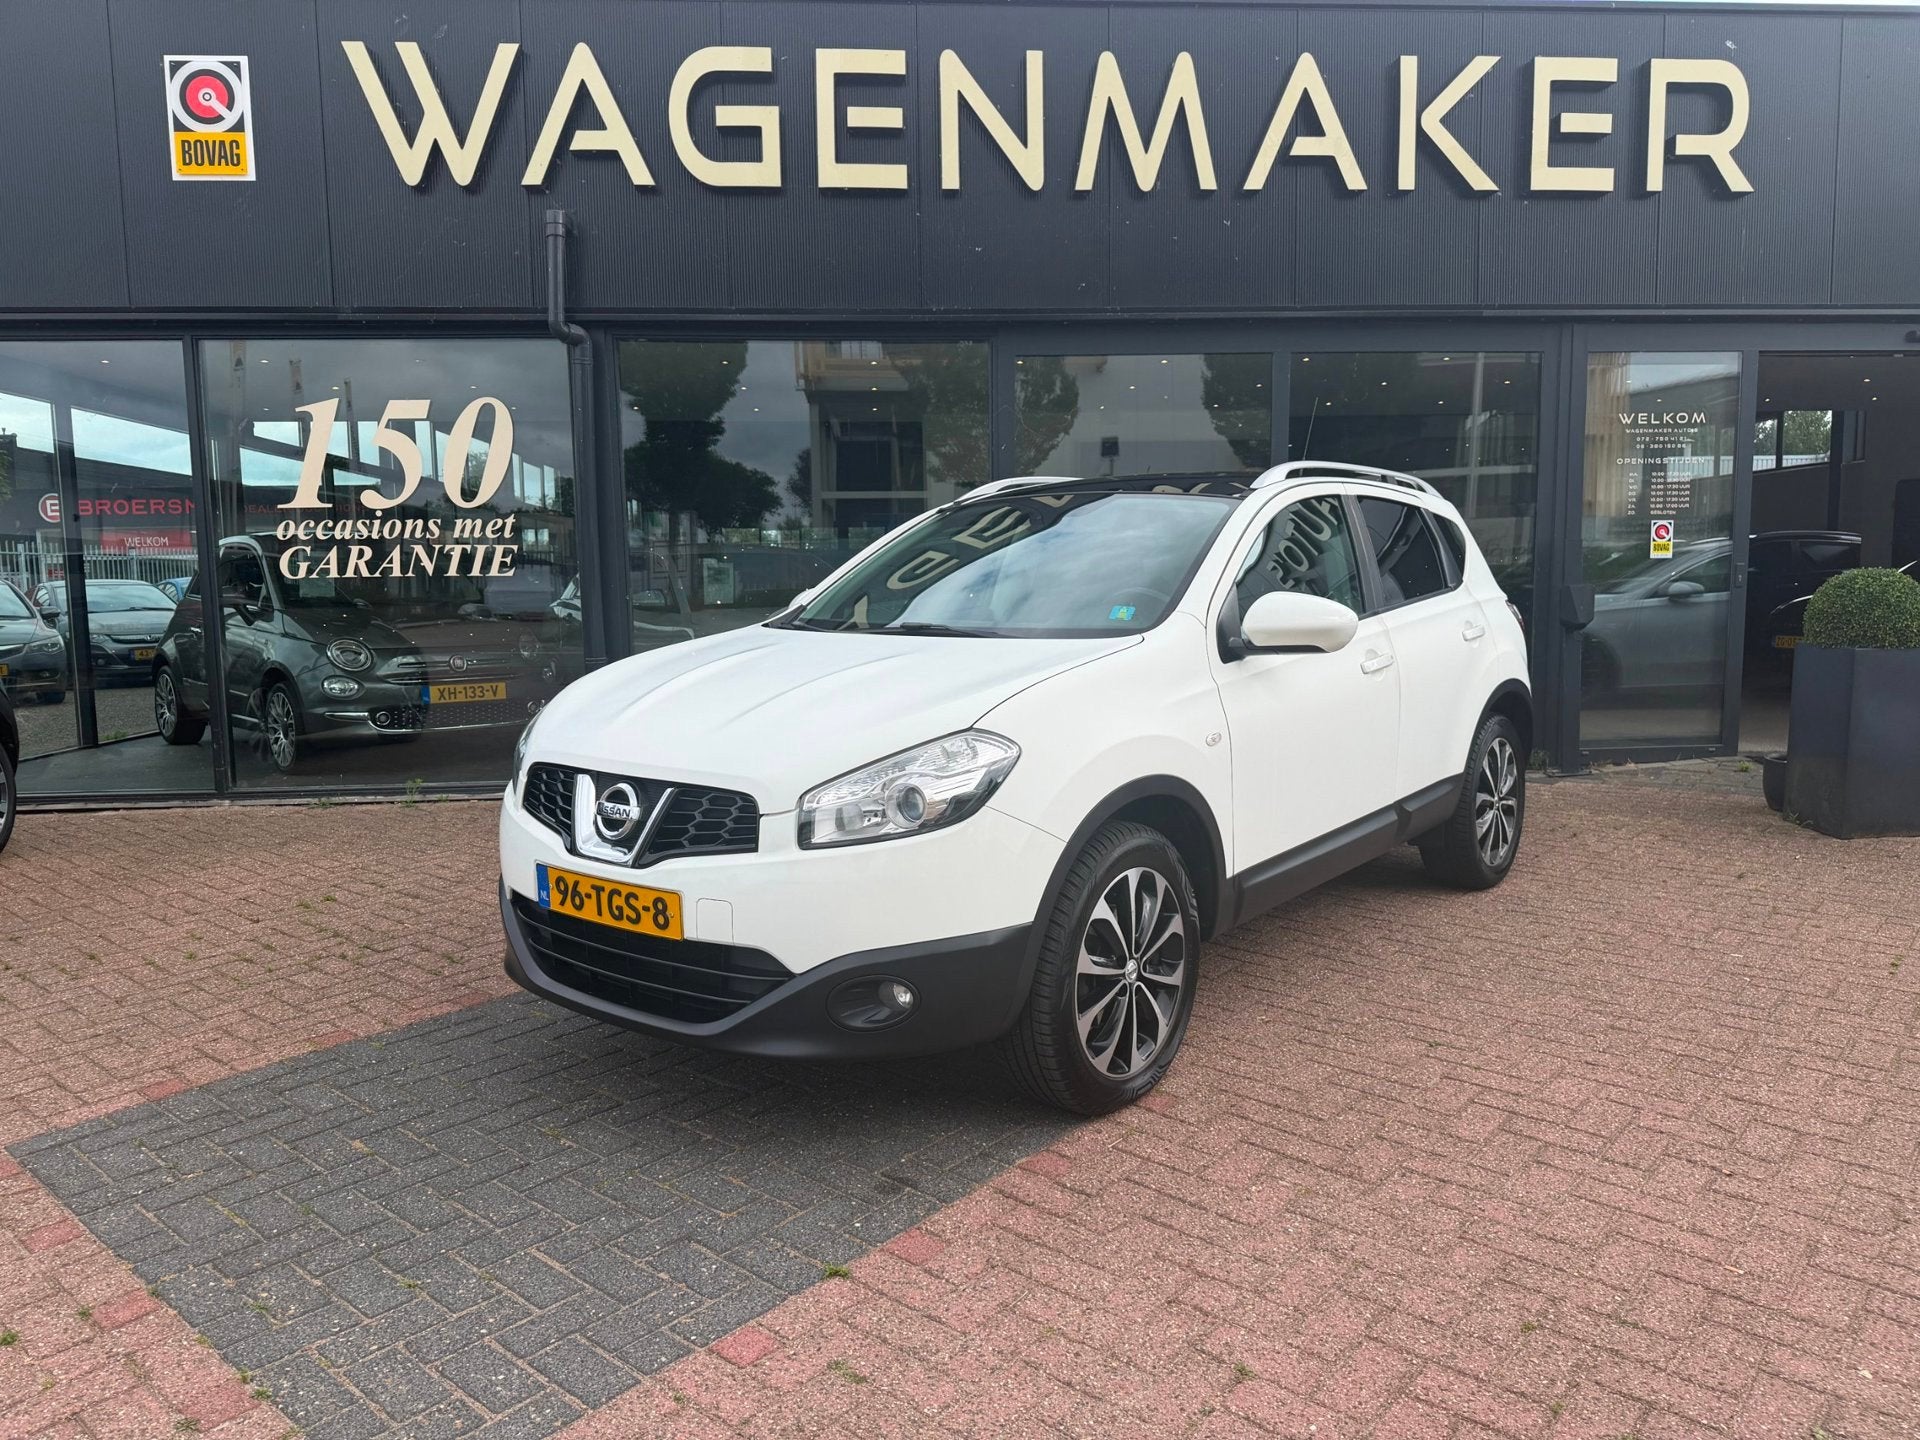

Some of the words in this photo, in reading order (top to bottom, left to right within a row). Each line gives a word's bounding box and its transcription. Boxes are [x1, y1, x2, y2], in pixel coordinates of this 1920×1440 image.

[341, 41, 1754, 192] WAGENMAKER
[181, 139, 241, 167] BOVAG
[1618, 412, 1706, 424] WELKOM
[277, 397, 513, 509] 150
[1616, 457, 1705, 465] OPENINGSTIJDEN
[276, 510, 441, 541] occasions
[452, 513, 516, 539] met
[124, 536, 169, 548] WELKOM
[279, 544, 519, 580] GARANTIE
[437, 685, 499, 701] XH-133-V
[540, 891, 549, 901] NL
[554, 875, 670, 931] 96-TGS-8
